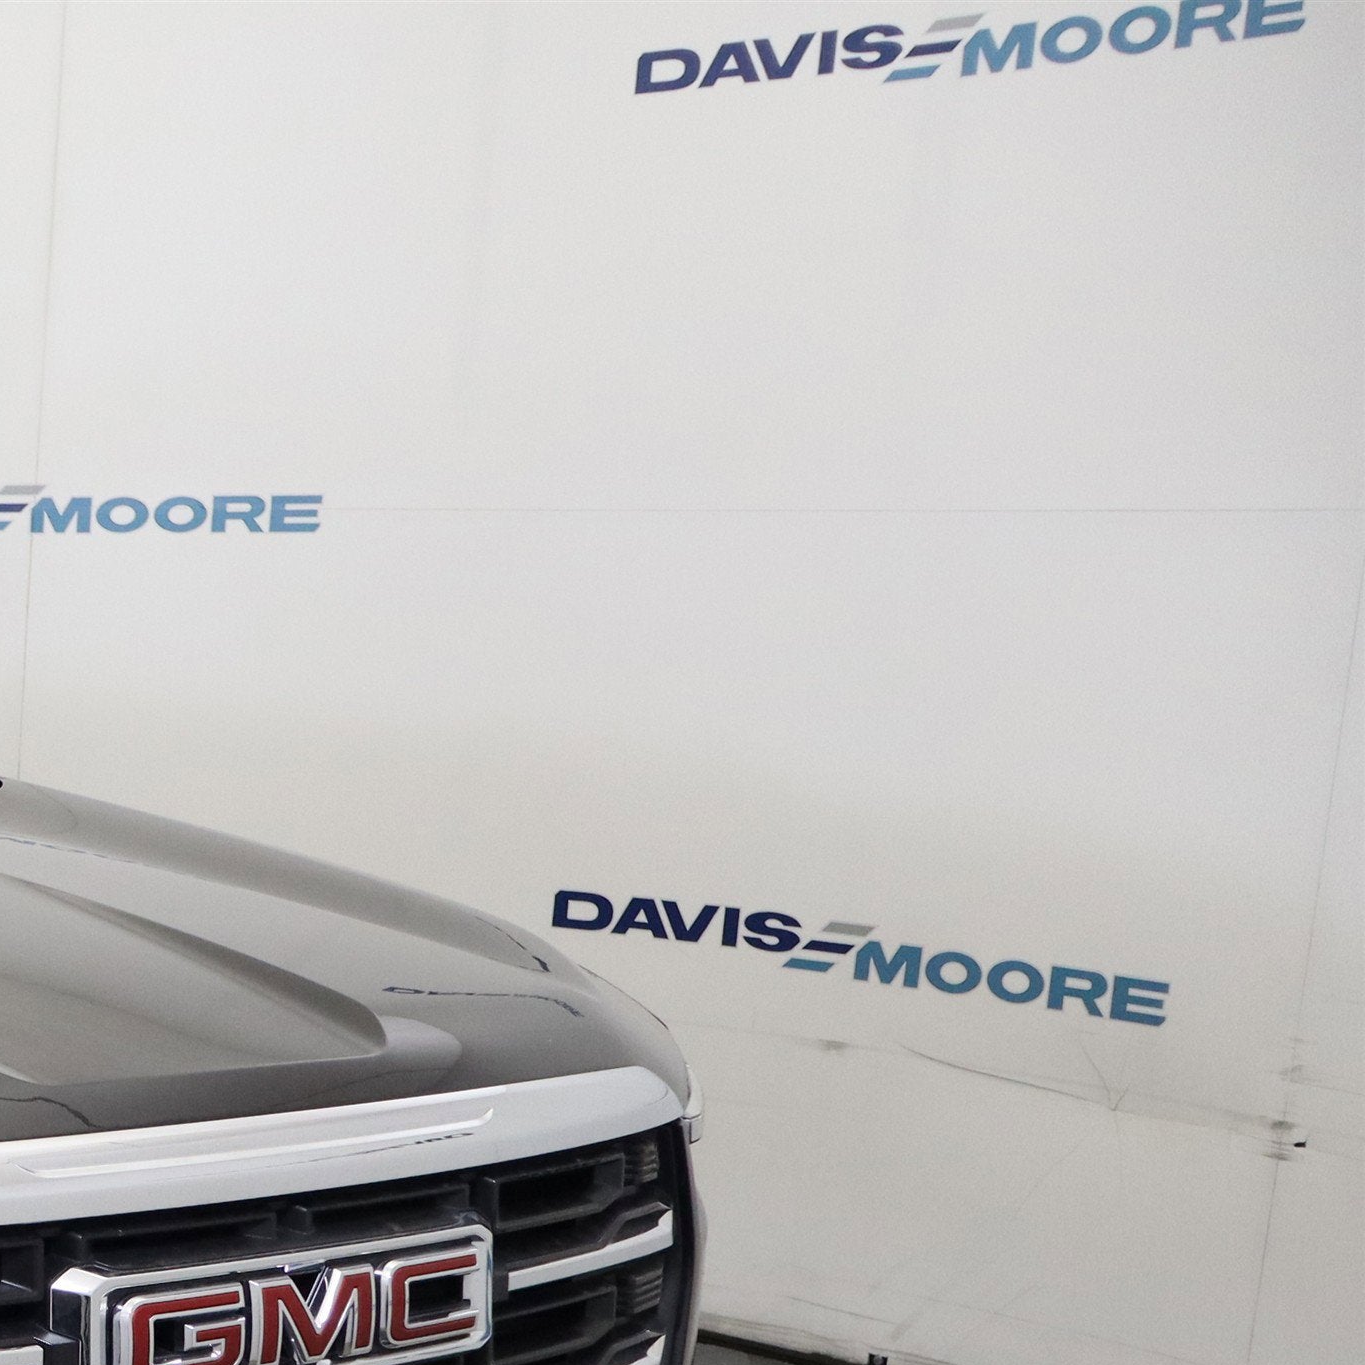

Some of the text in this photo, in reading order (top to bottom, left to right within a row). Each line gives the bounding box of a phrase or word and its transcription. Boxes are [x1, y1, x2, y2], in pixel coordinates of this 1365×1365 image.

[634, 0, 1307, 95] DAVIS MOORE
[30, 494, 323, 533] MOORE
[551, 889, 1170, 1027] DAVIS MOORE
